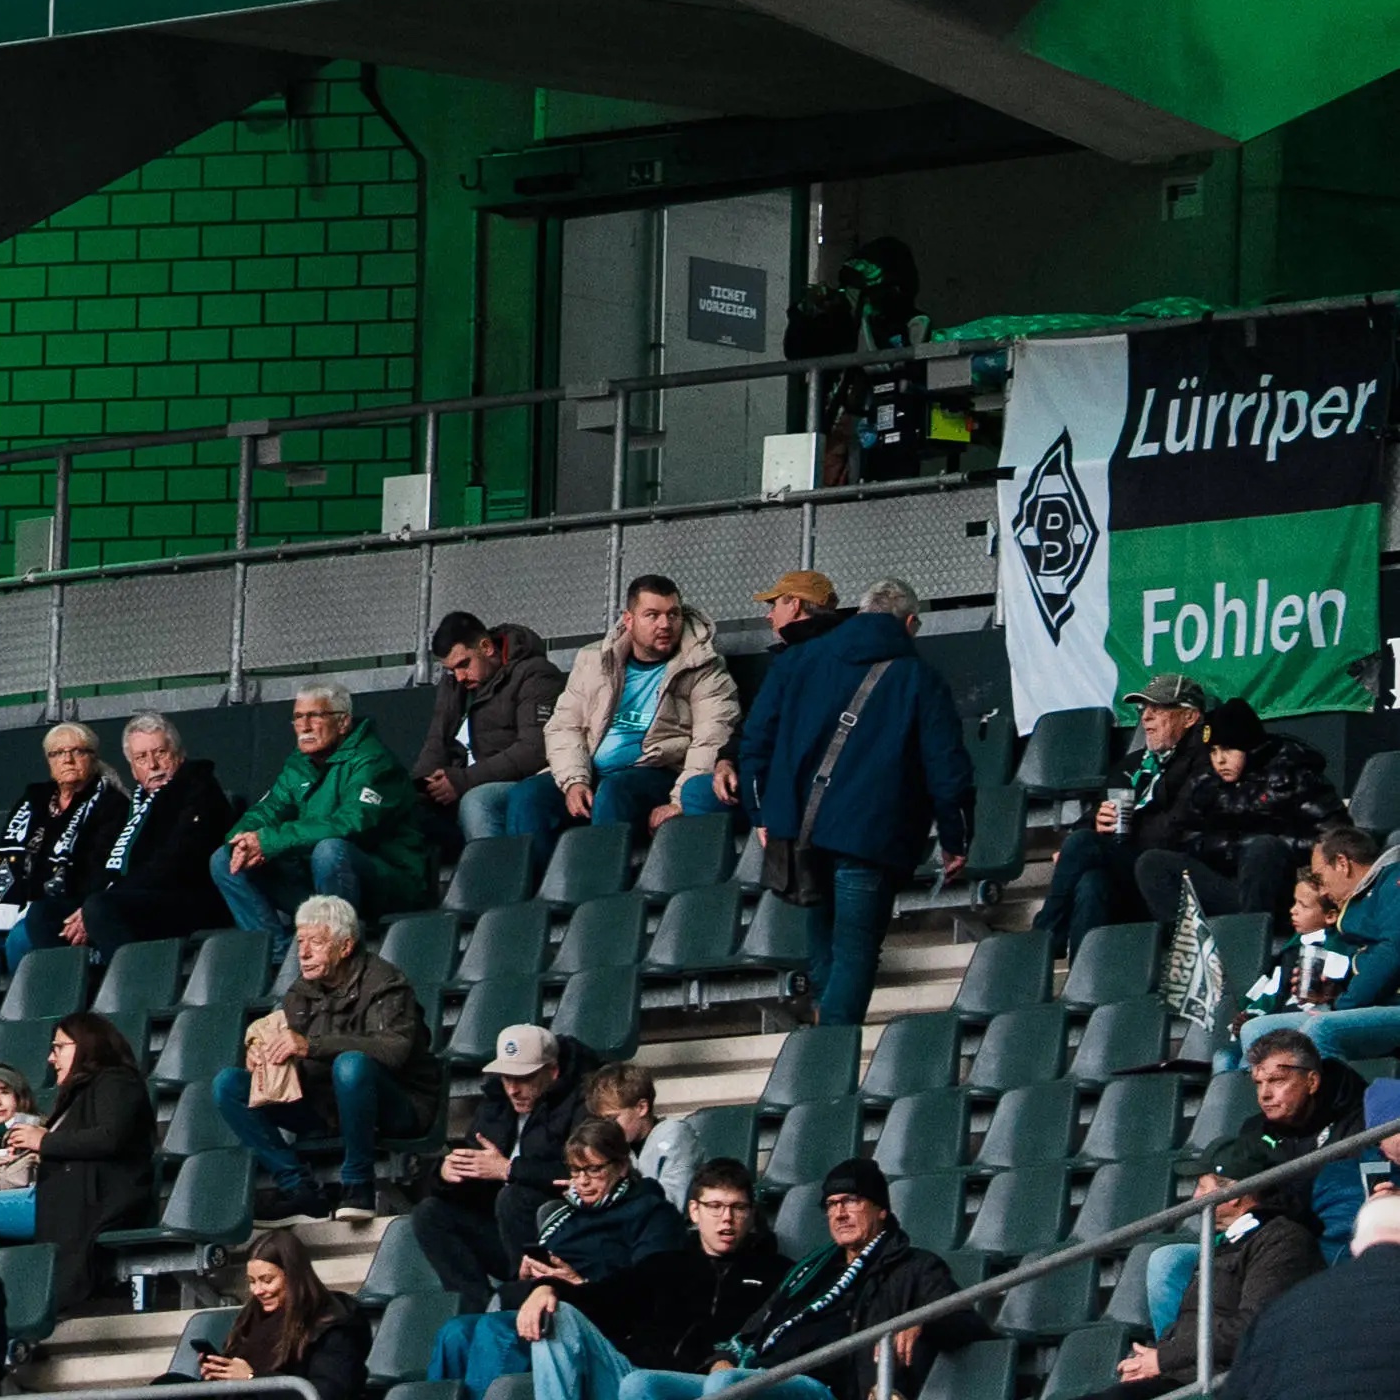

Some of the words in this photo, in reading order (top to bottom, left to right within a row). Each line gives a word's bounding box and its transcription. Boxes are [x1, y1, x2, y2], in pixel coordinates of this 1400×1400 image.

[698, 298, 757, 320] VORZEIGEN
[709, 285, 748, 303] TICKET
[1128, 374, 1378, 462] Lürriper
[1142, 578, 1347, 667] Fohlen
